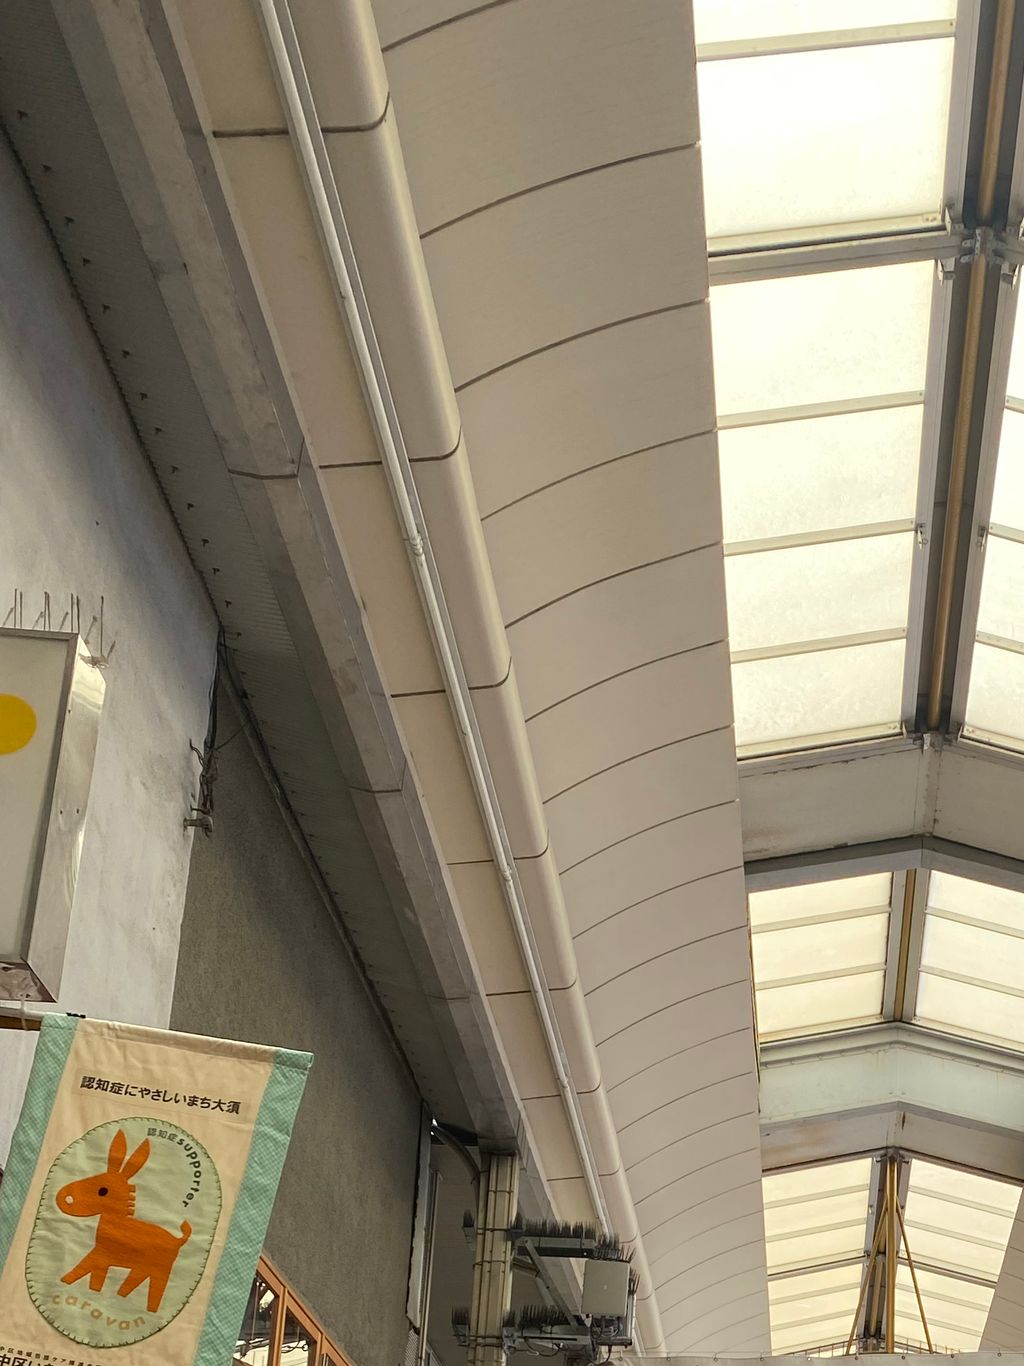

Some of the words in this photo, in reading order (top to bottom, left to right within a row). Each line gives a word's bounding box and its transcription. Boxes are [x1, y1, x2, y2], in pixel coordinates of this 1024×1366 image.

[80, 1076, 241, 1114] 認知症にやさしいまち大須
